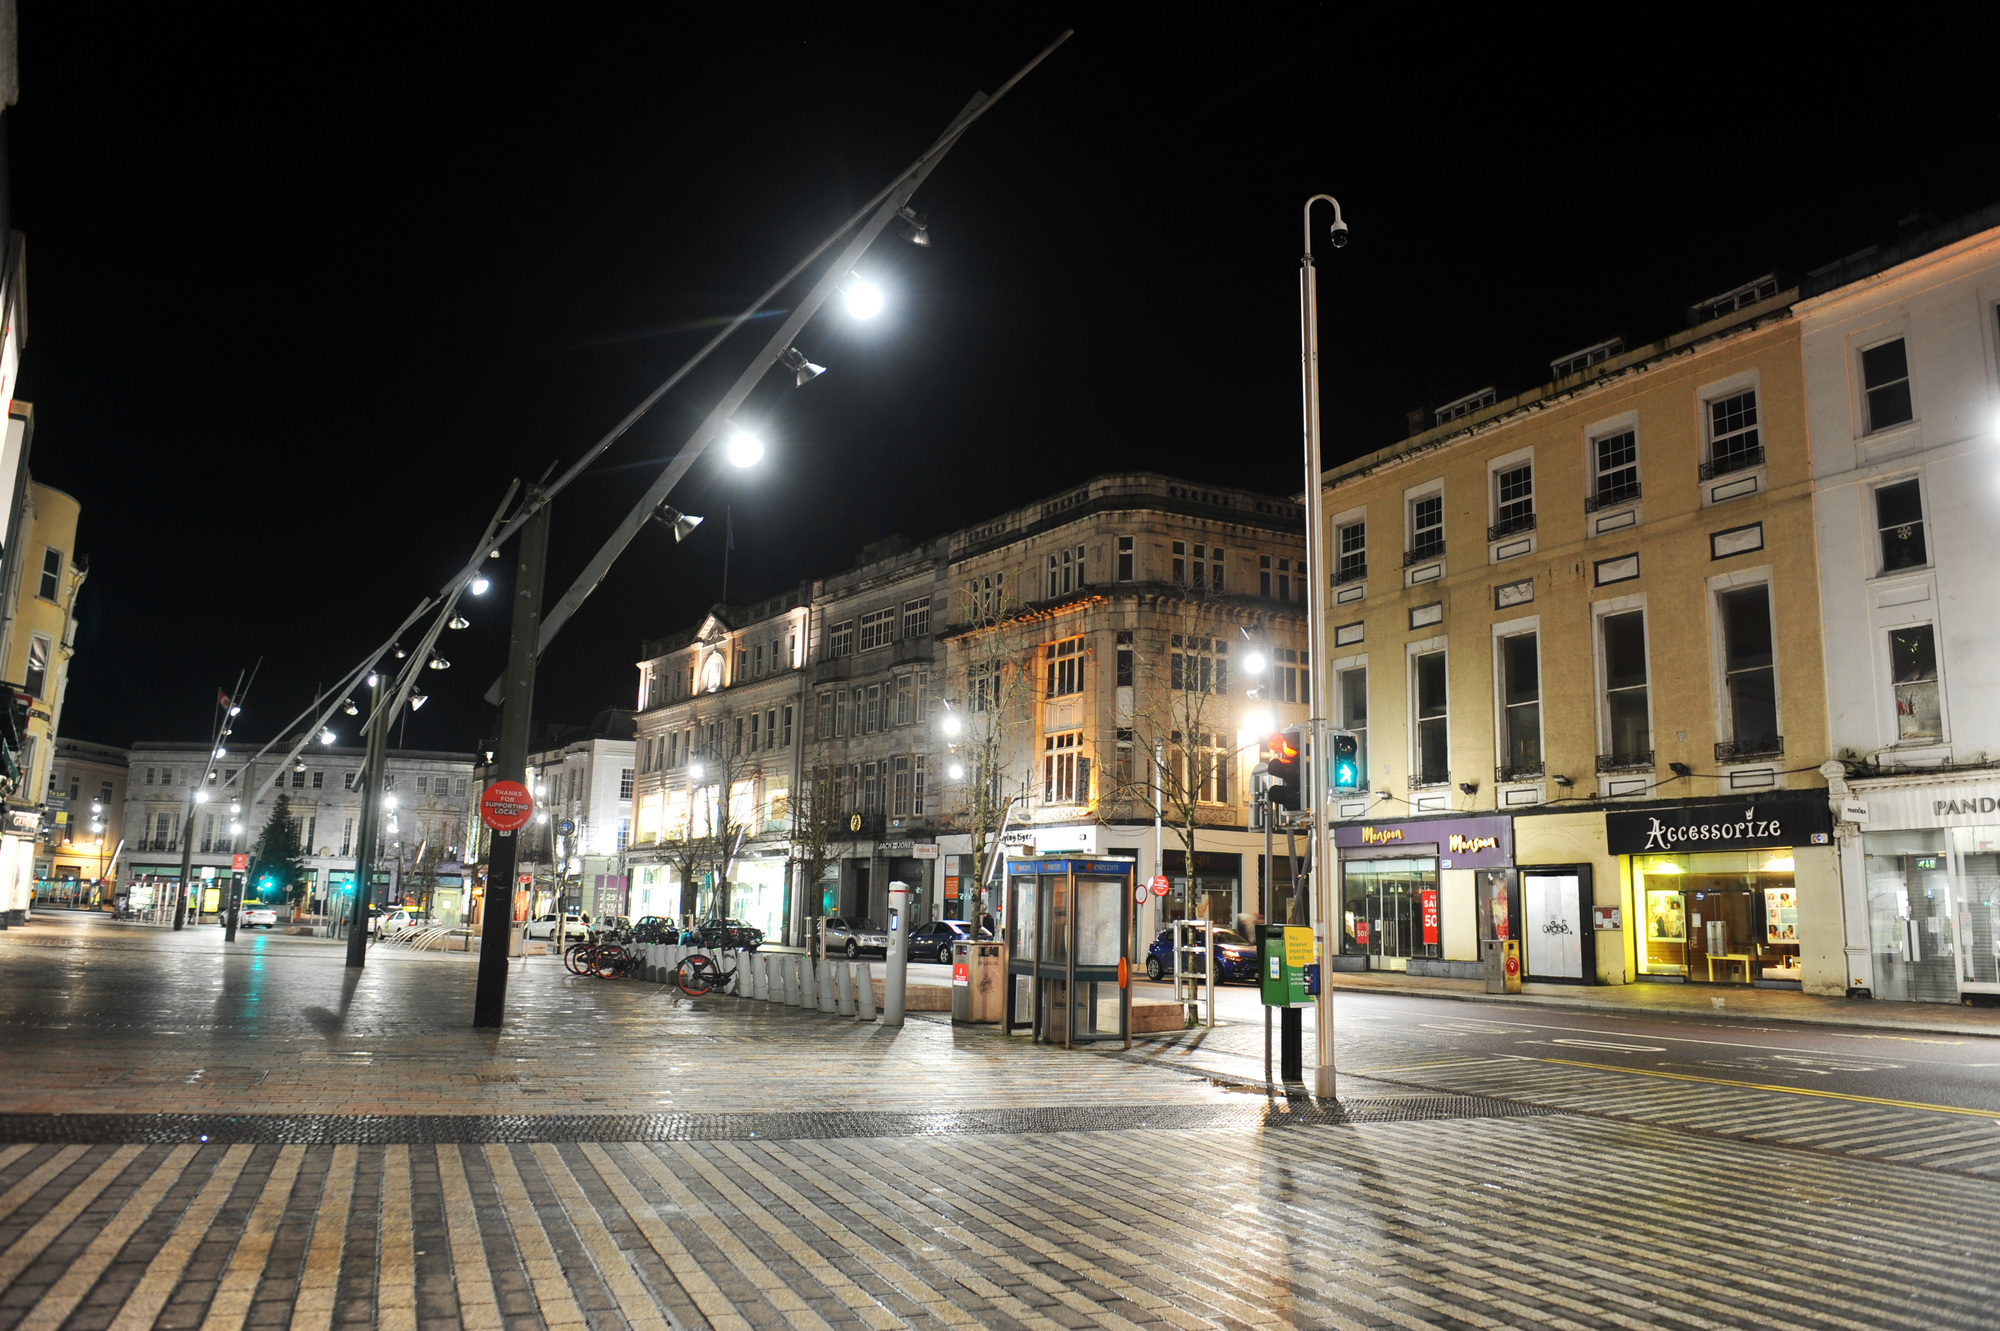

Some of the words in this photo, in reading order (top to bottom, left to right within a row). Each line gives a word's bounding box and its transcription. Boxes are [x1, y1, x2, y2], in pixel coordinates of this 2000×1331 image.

[495, 789, 522, 797] THANKS
[485, 801, 529, 810] SUPPORTING
[1933, 797, 2000, 816] PAND
[494, 808, 517, 816] LOCAL
[512, 818, 523, 827] share
[1644, 807, 1782, 850] Accessorize
[1017, 833, 1032, 842] tiger
[1361, 827, 1404, 844] Monsoon
[879, 842, 892, 850] JACK
[897, 841, 915, 849] JONES
[1449, 834, 1498, 854] Monsoon
